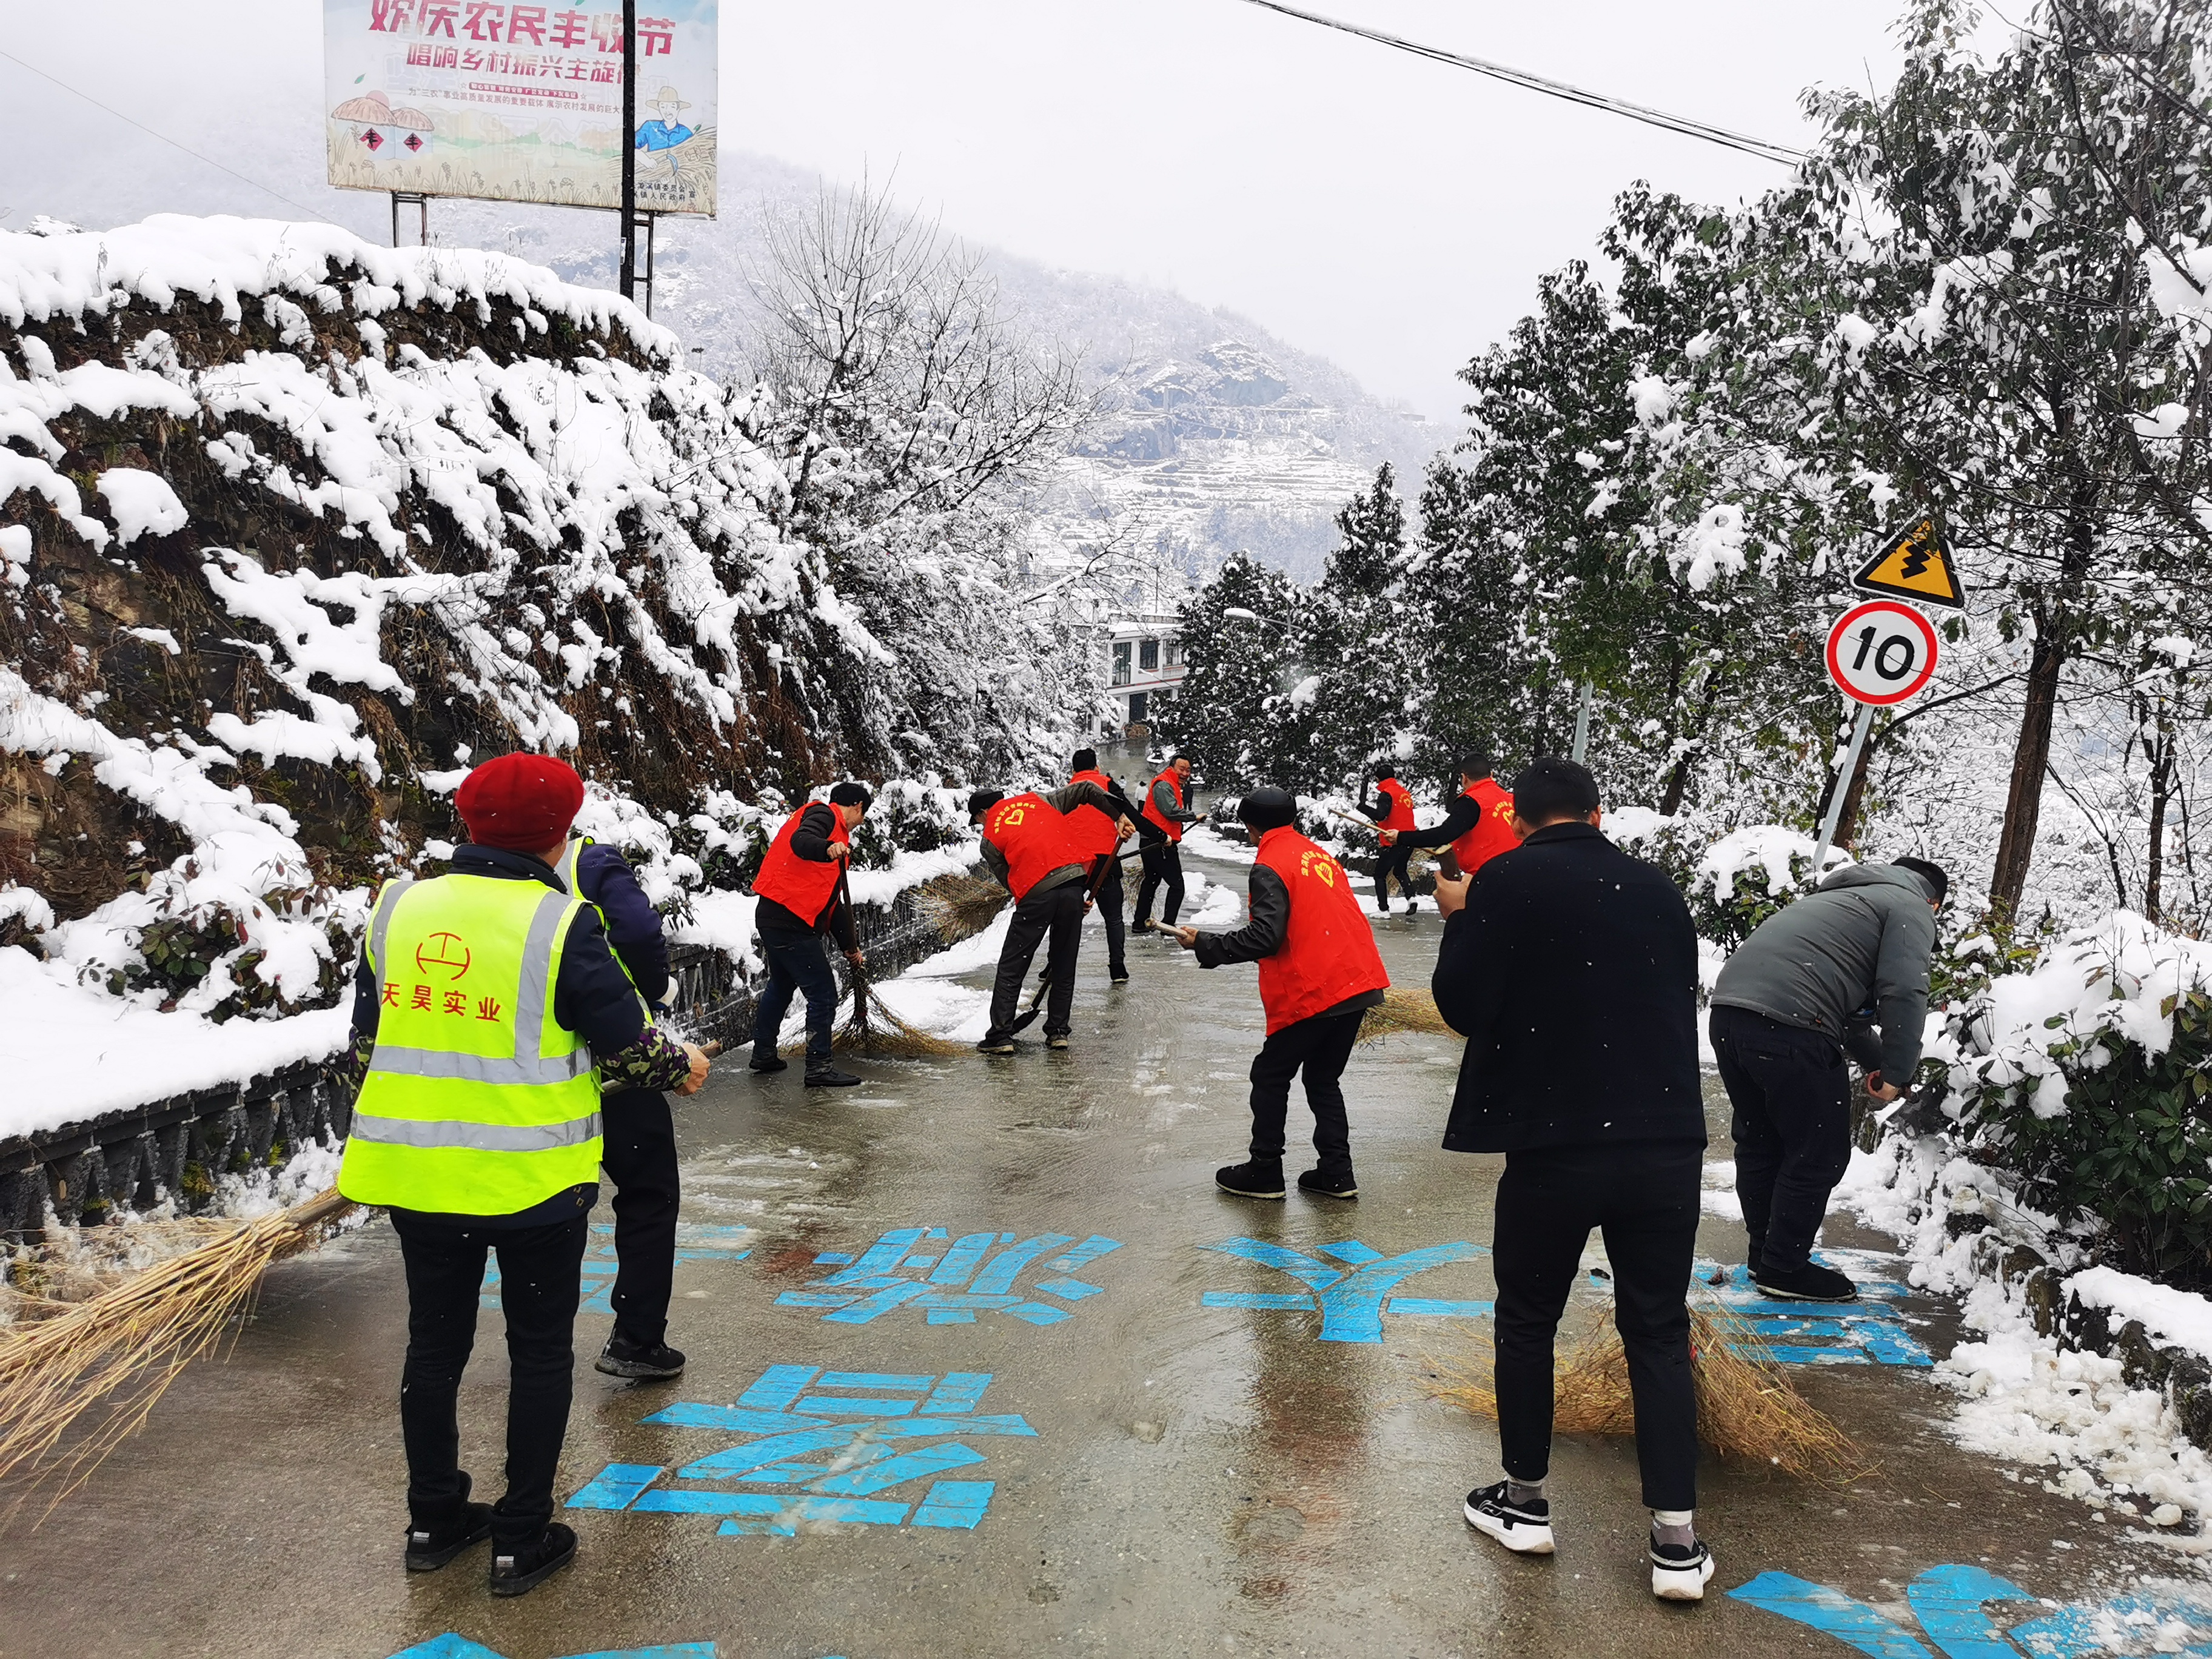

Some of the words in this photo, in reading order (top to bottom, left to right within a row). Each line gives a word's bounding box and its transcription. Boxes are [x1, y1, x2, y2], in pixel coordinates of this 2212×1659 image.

[1852, 626, 1914, 680] 10
[381, 982, 501, 1022] 天昊实业
